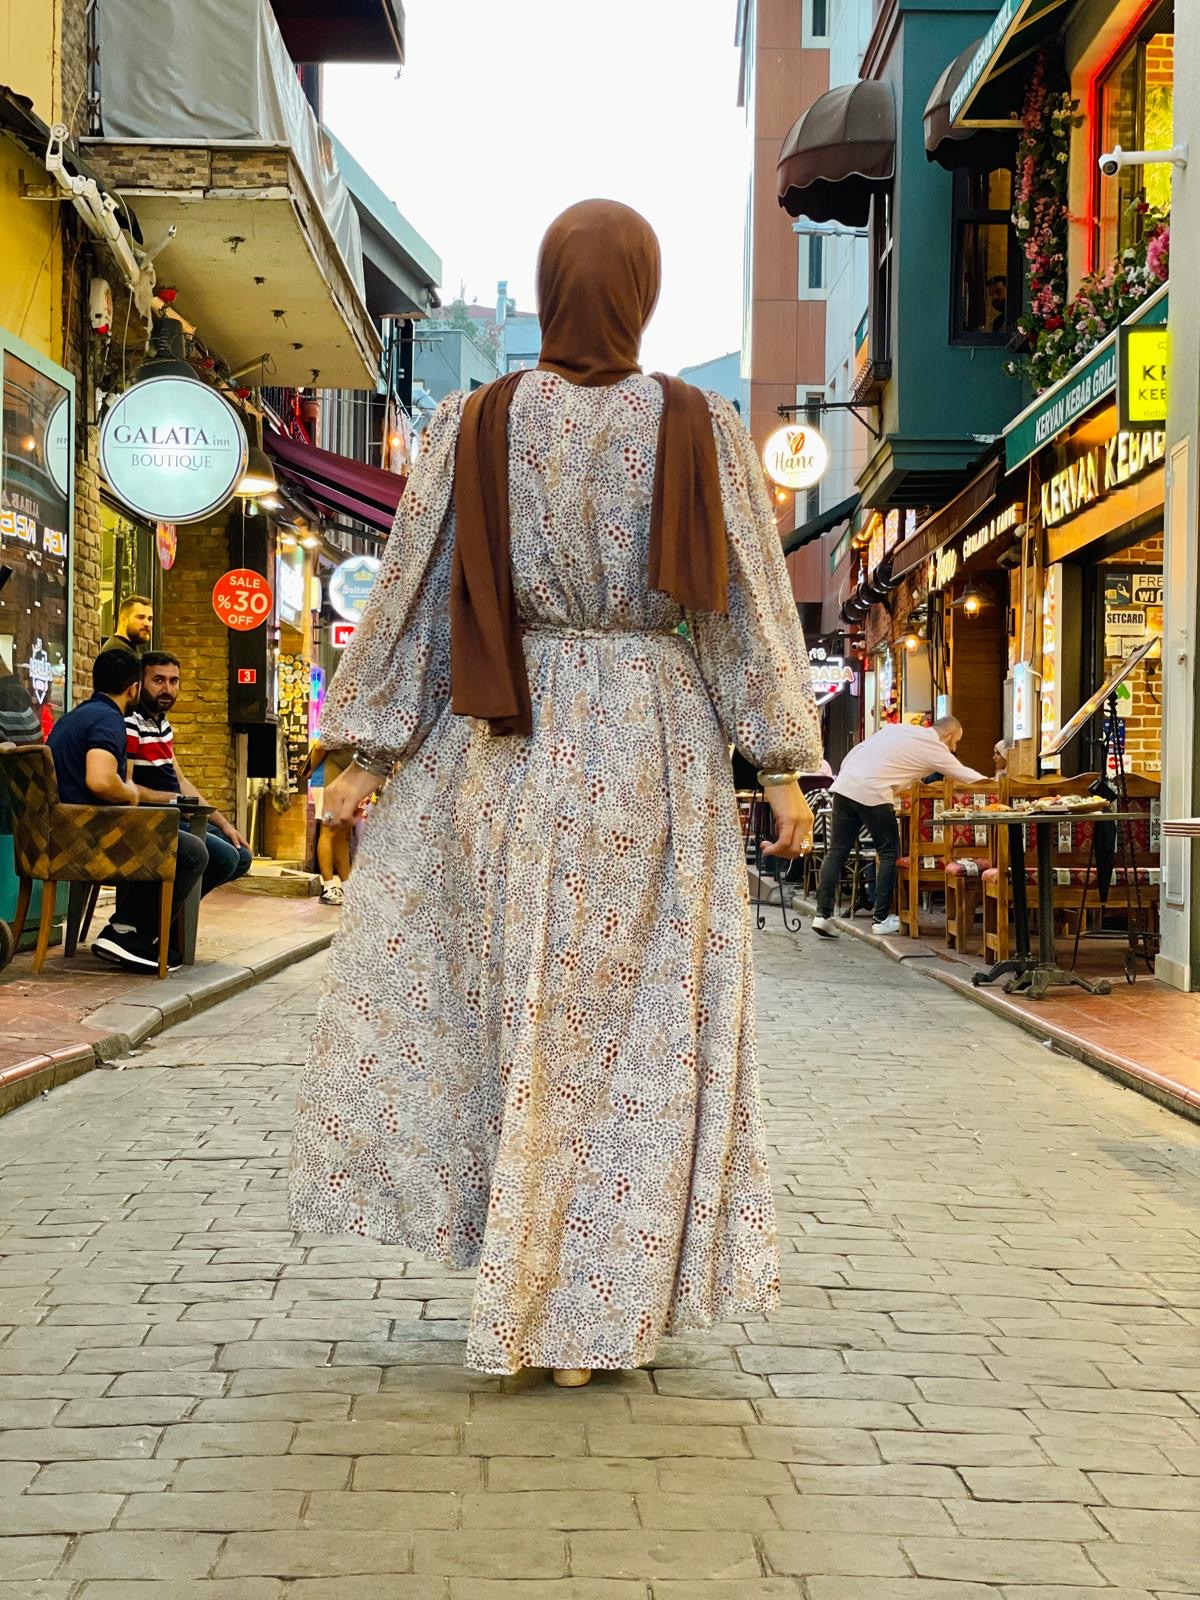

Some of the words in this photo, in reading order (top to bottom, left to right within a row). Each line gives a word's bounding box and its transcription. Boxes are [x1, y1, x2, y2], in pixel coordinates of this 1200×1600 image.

[1035, 398, 1065, 444] KERVAN
[1065, 376, 1092, 419] KEBAB
[1092, 354, 1117, 397] GRILL
[113, 425, 210, 446] GALATA
[212, 435, 231, 447] inn
[131, 454, 213, 471] BOUTIQUE
[1041, 446, 1099, 529] KERVAN
[1104, 431, 1166, 490] KEBAB
[229, 576, 261, 589] SALE
[228, 614, 254, 626] OFF
[1106, 613, 1143, 624] SETCARD
[243, 670, 252, 682] 3
